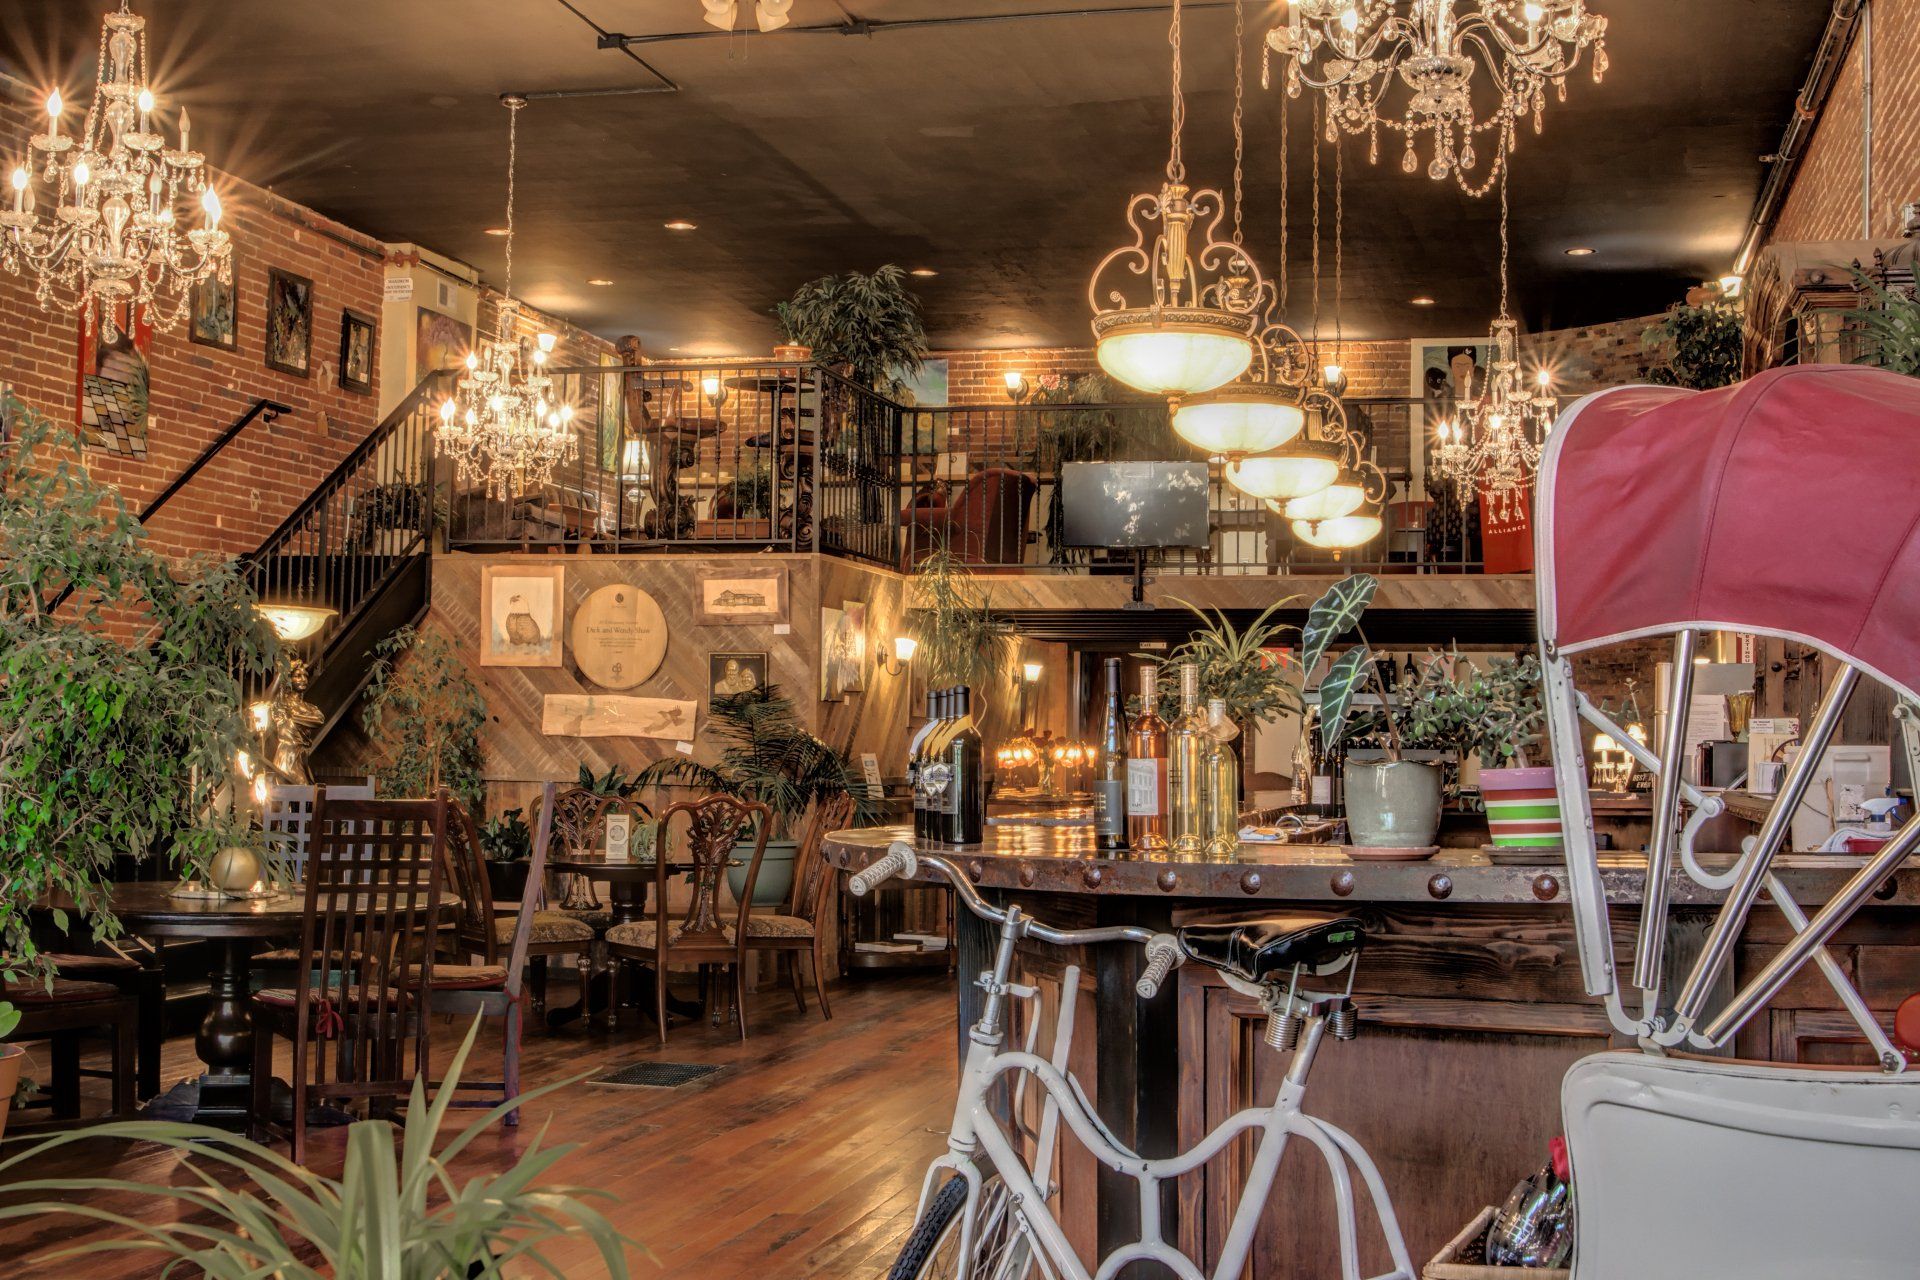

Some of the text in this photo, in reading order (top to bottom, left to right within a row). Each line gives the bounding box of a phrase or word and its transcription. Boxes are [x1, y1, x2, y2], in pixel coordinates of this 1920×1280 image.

[1488, 525, 1526, 534] ALLIANCE
[586, 626, 600, 634] Dick
[612, 626, 634, 636] Wendy
